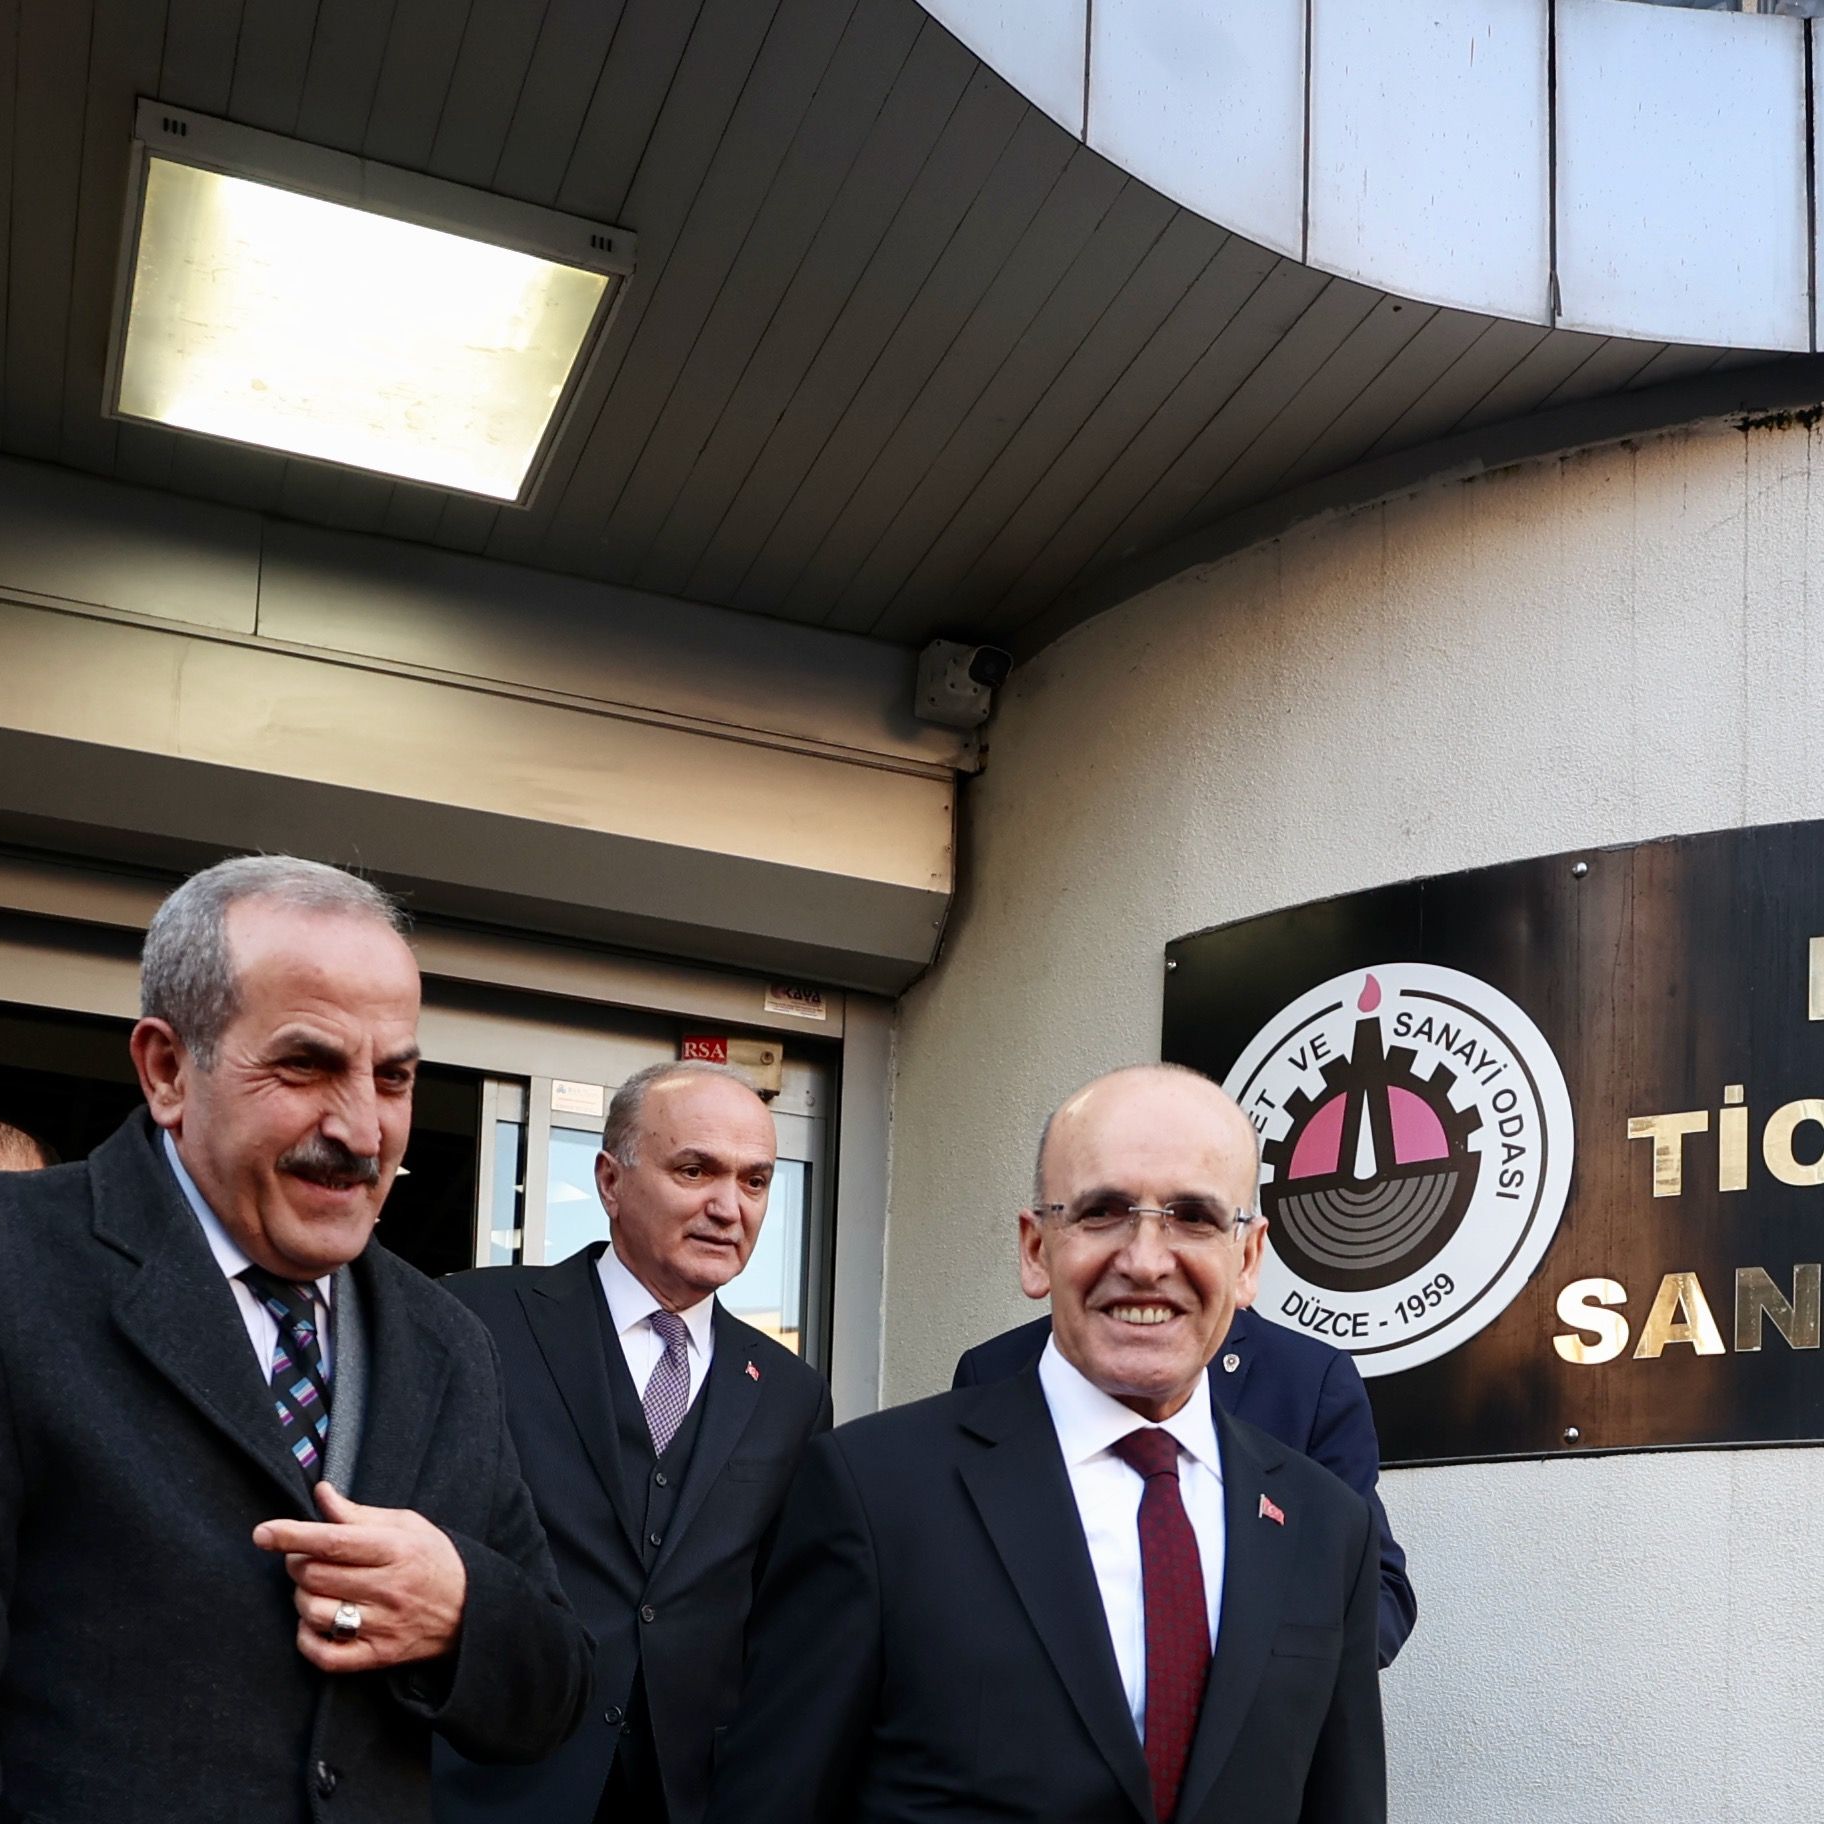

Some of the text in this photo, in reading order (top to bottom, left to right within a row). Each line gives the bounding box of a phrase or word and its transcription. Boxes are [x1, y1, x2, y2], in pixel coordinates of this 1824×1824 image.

[684, 1042, 725, 1058] RSA
[1288, 1032, 1332, 1074] VE
[1392, 1011, 1509, 1087] SANAYİ
[1491, 1087, 1527, 1200] ODASI
[1280, 1289, 1370, 1337] DÜZCE
[1393, 1272, 1456, 1325] 1959
